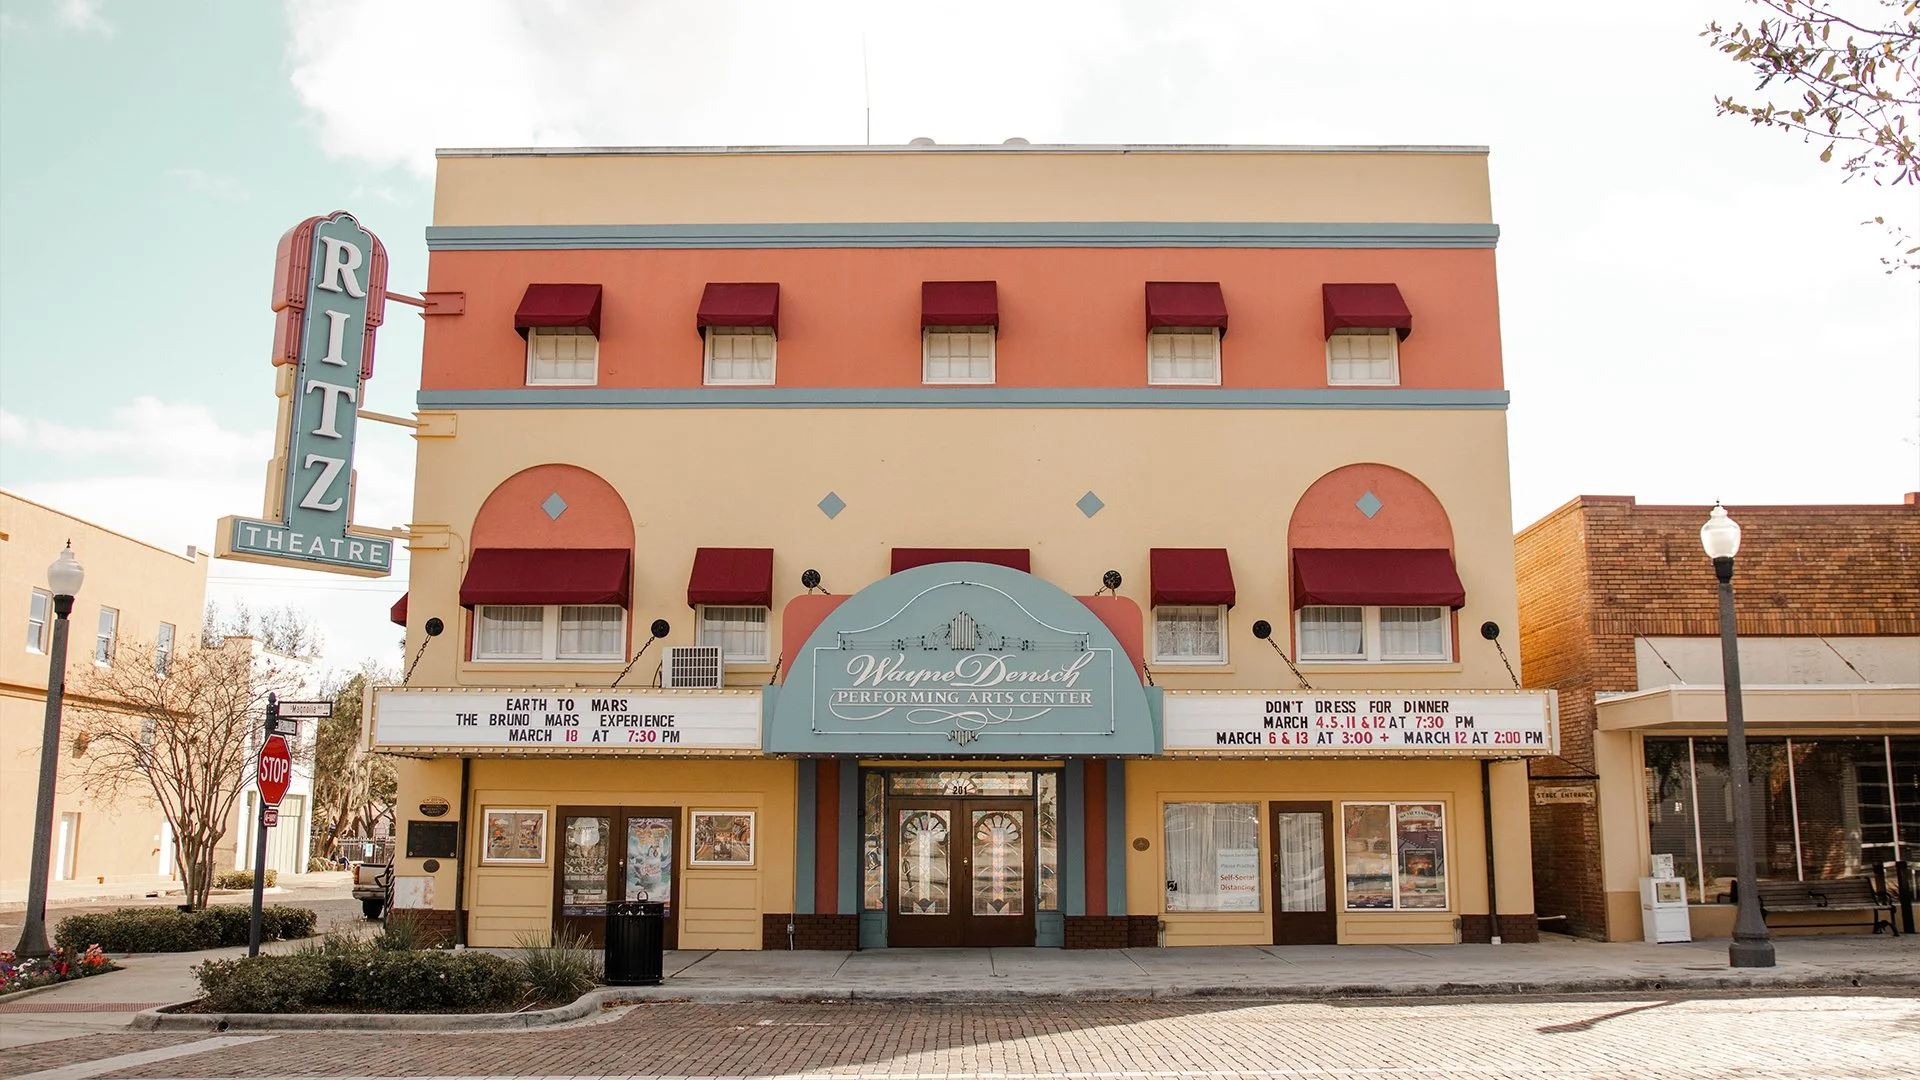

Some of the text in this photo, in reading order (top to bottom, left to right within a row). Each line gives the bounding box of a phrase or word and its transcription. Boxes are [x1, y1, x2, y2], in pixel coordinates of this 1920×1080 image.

[300, 235, 366, 512] RITZ
[246, 526, 383, 564] THEATRE
[846, 650, 1095, 688] Wayne Densch
[838, 691, 1092, 704] PERFORMING ARTS CENTER
[506, 698, 628, 712] EARTH TO MARS
[1265, 701, 1449, 713] DON'T DRESS FOR DINNER
[456, 714, 675, 727] THE BRUNO MARS EXPERIENCE
[1263, 716, 1308, 728] MARCH
[1361, 716, 1370, 728] &
[1373, 716, 1385, 728] 12
[1389, 716, 1406, 728] AT
[1415, 716, 1444, 728] 7:30
[1455, 716, 1474, 728] PM
[508, 729, 680, 742] MARCH 18 AT 7:30 PM
[1216, 732, 1262, 744] MARCH
[1268, 732, 1276, 744] 6
[1281, 732, 1290, 744] &
[1296, 732, 1308, 744] 13
[1317, 732, 1334, 744] AT
[1342, 732, 1373, 744] 3:00
[1404, 732, 1451, 744] MARCH
[1455, 732, 1468, 744] 12
[1472, 732, 1489, 744] AT
[1494, 732, 1521, 744] 2:00
[1525, 732, 1543, 744] PM
[261, 756, 288, 783] STOP
[952, 785, 968, 795] 201
[1220, 873, 1255, 881] Self-Social
[1220, 884, 1256, 893] Distancing
